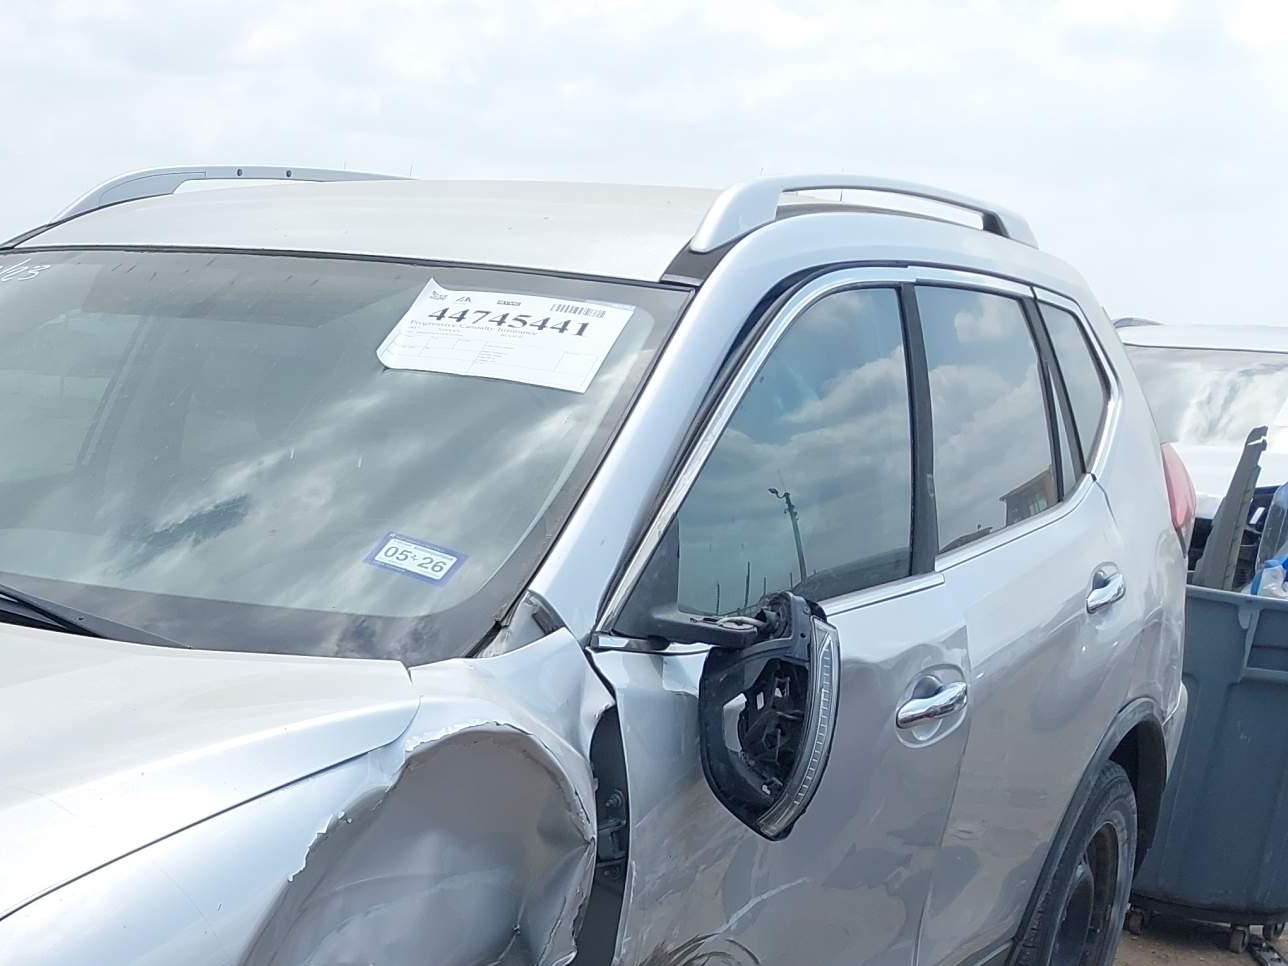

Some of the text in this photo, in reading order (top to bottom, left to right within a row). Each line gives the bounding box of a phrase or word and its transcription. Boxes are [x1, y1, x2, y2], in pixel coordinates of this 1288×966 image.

[428, 308, 589, 336] 44745441
[383, 546, 413, 562] 05
[416, 556, 448, 573] 26
